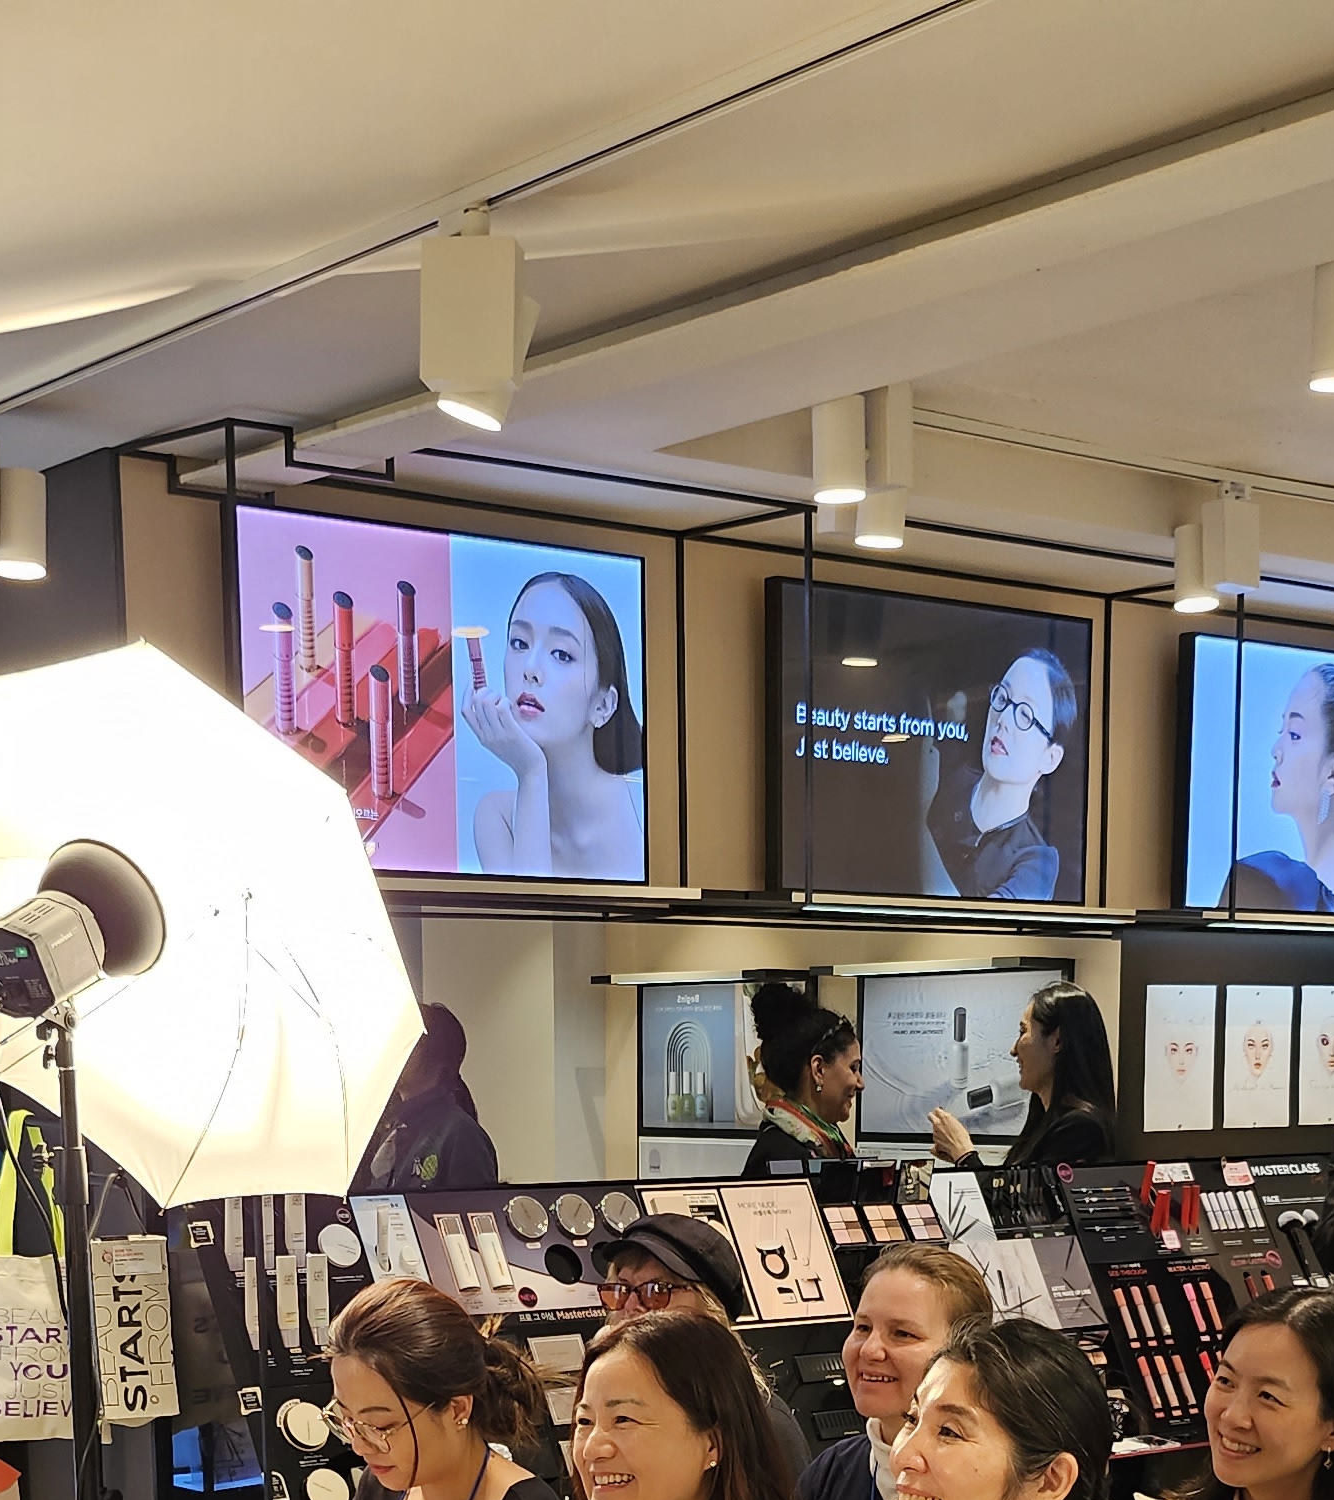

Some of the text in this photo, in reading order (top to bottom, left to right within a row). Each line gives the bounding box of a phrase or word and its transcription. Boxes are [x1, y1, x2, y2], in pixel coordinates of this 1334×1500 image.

[853, 708, 896, 733] starts
[899, 712, 935, 737] from
[937, 721, 969, 742] you,
[795, 735, 889, 765] Jst believe.
[1250, 1163, 1321, 1176] MASTERCLASS
[556, 1308, 607, 1320] Masterclass
